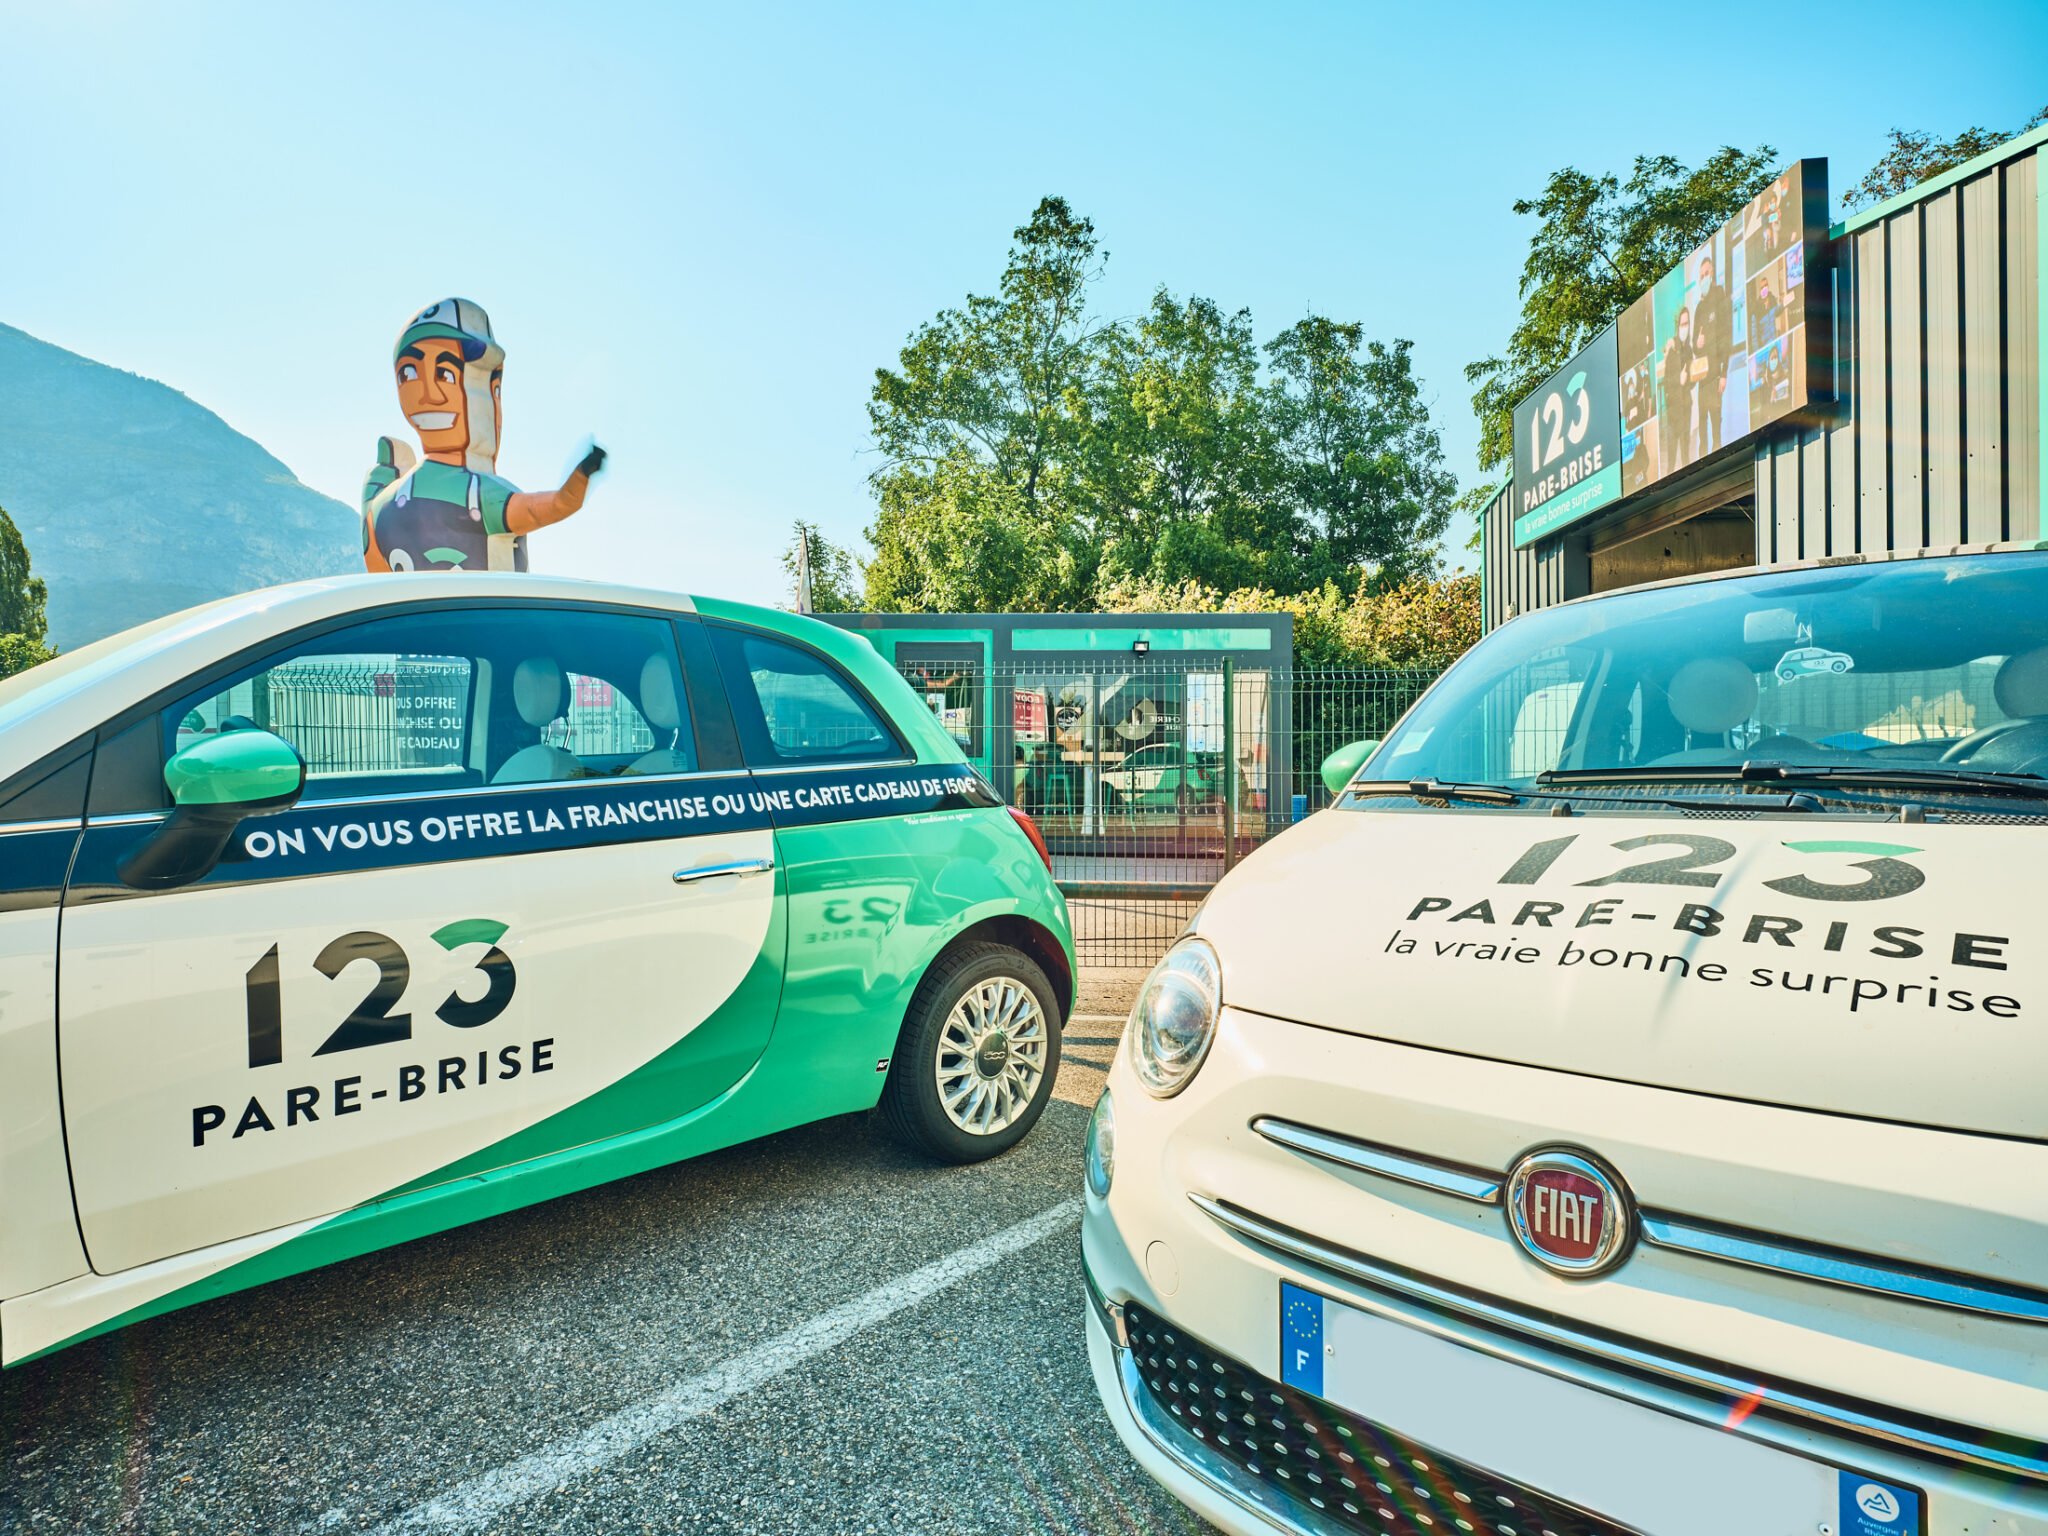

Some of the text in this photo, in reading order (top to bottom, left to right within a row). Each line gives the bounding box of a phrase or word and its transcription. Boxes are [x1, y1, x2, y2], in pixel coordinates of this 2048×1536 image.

[1531, 371, 1590, 474] 123
[1524, 444, 1603, 513] PARE-BRISE
[1524, 481, 1603, 534] la vraie bonne surprise
[414, 697, 457, 709] OFFRE
[439, 717, 462, 729] OU
[407, 736, 460, 750] CADEAU
[245, 828, 306, 859] ON
[312, 819, 414, 852] VOUS
[421, 811, 523, 842] OFFRE
[527, 807, 564, 834] LA
[568, 796, 709, 830] FRANCHISE
[711, 793, 746, 816] OU
[747, 789, 794, 812] UNE
[794, 784, 854, 808] CARTE
[854, 780, 920, 802] CADEAU
[920, 778, 944, 797] DE
[1497, 833, 1926, 901] 123
[1406, 896, 2010, 971] PARE-BRISE
[246, 918, 516, 1069] 123
[1384, 930, 2022, 1018] la vraie bonne surprise
[193, 1037, 555, 1148] PARE-BRISE
[1534, 1184, 1598, 1246] FIAT
[1296, 1348, 1310, 1372] F
